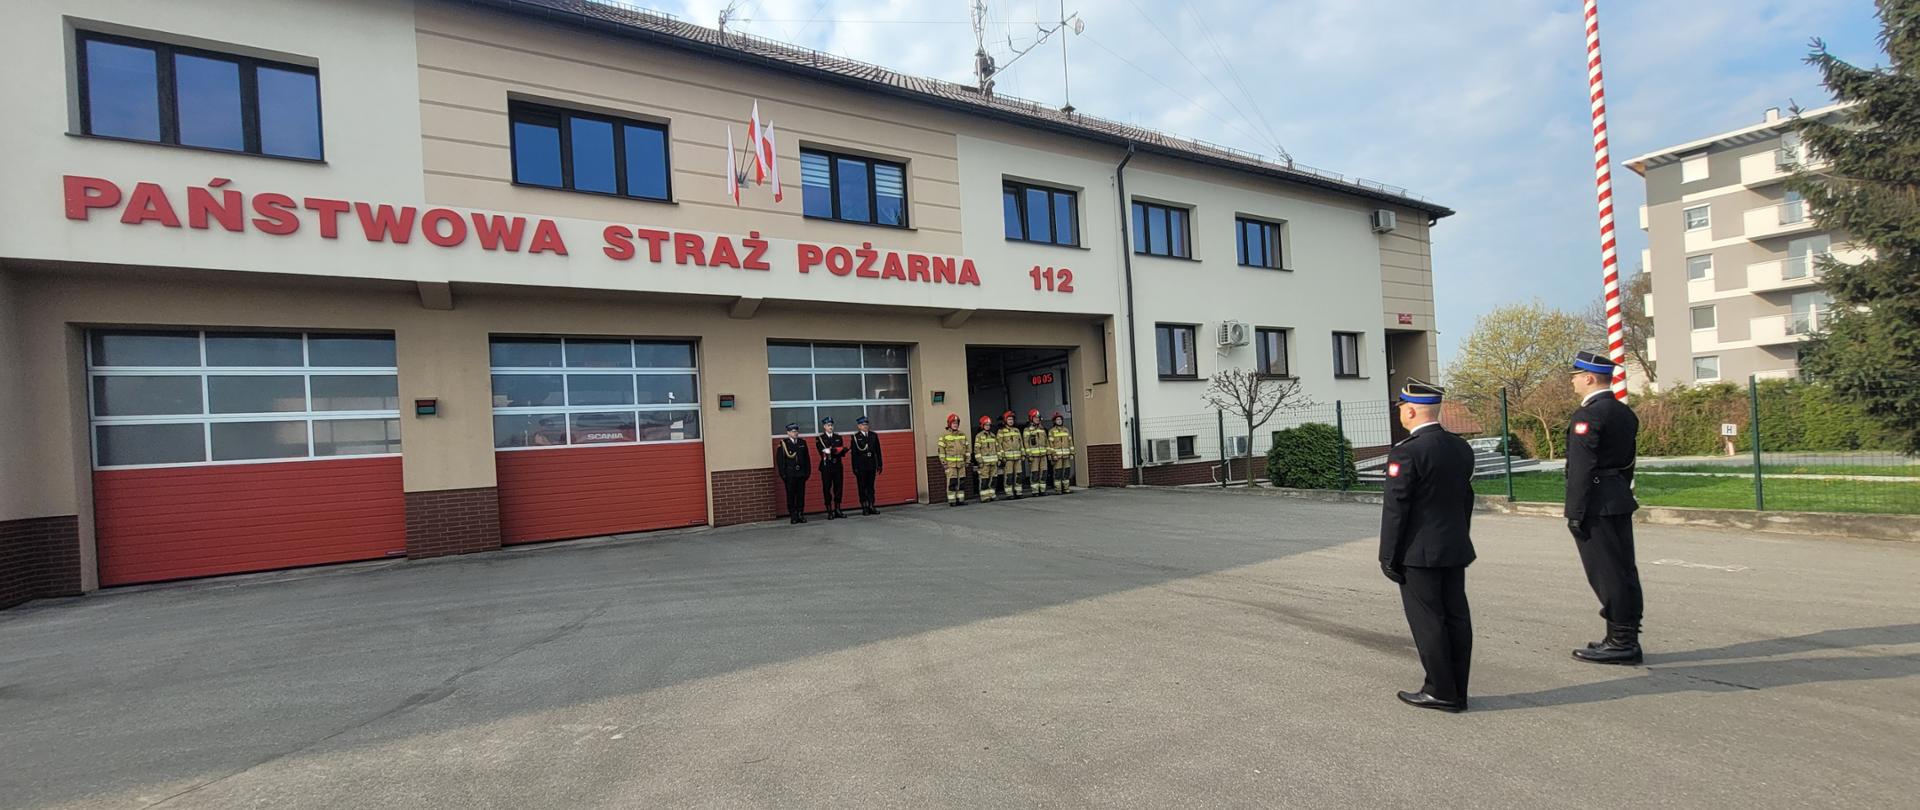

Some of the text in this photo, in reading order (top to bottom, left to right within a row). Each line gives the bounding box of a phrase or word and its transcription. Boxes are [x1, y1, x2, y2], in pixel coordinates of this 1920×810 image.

[63, 175, 1074, 293] PAŃSTWOWA STRAŻ POŻARNA 112
[1726, 425, 1733, 434] H
[586, 432, 624, 440] SCANIA
